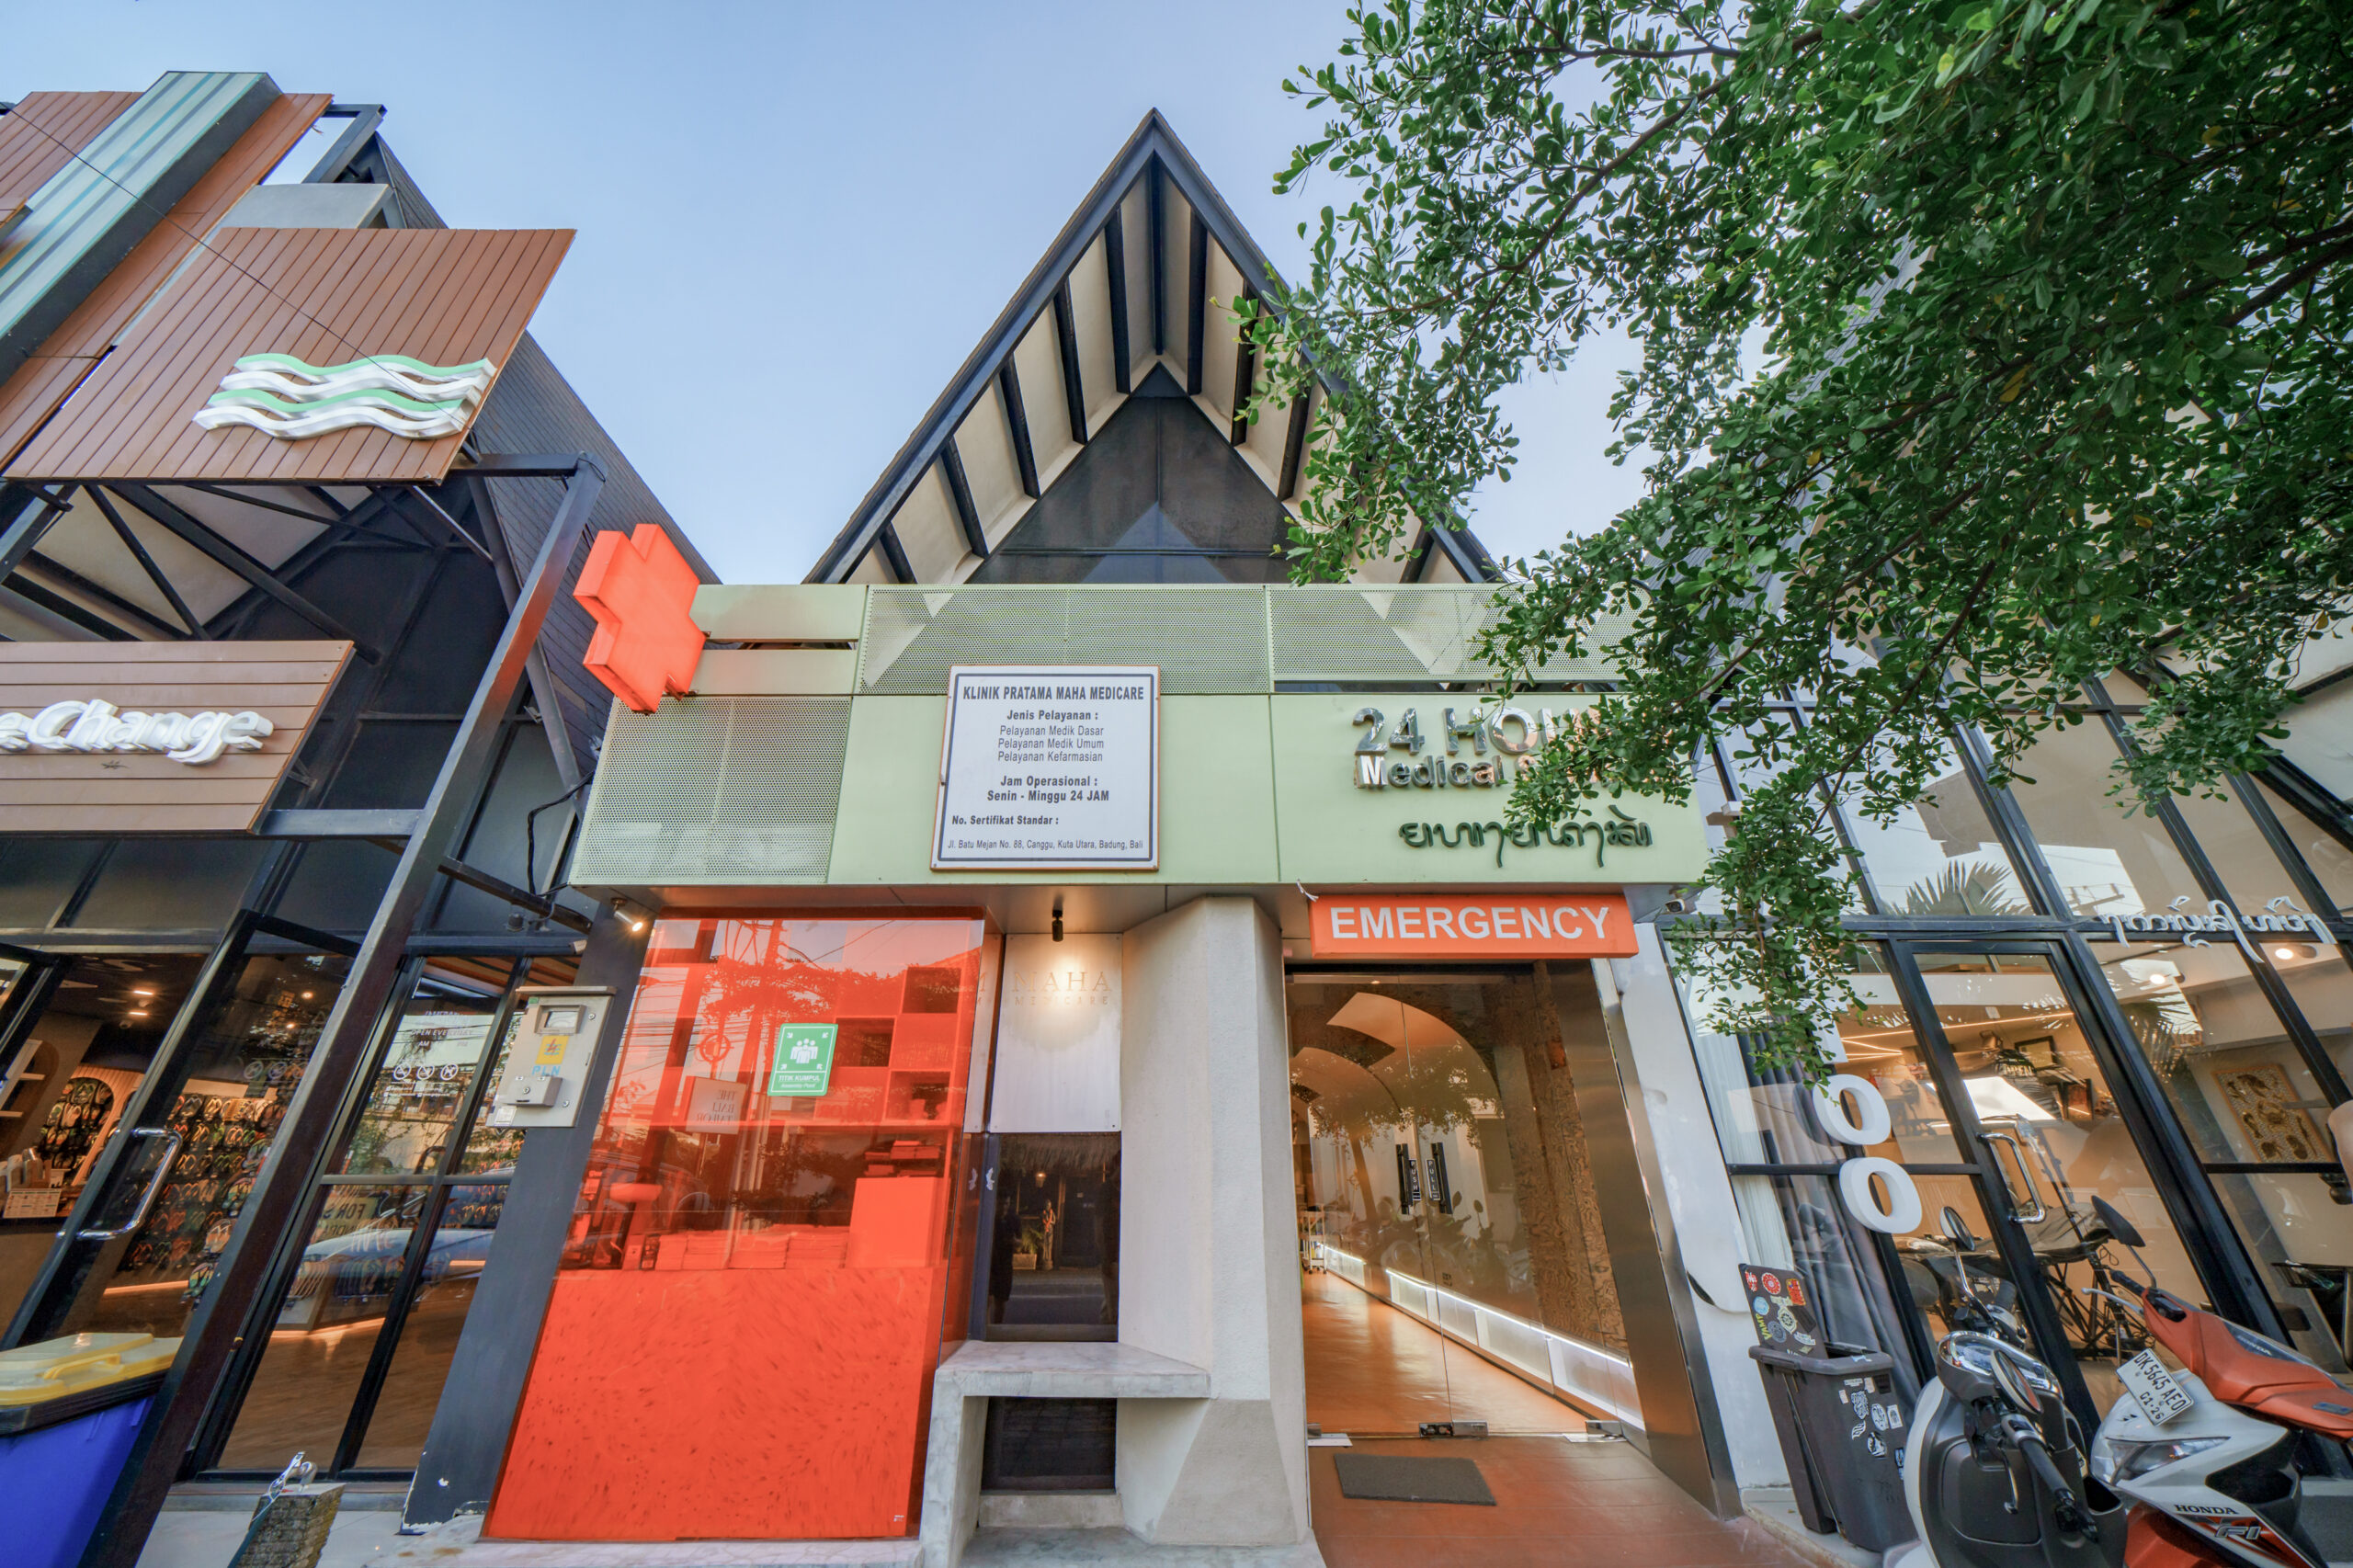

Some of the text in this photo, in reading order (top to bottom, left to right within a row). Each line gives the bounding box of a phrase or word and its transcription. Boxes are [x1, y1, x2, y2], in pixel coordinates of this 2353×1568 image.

[963, 686, 1144, 699] KLINIK PRATAMA MAHA MEDICARE
[1006, 710, 1035, 720] Jenis
[1039, 710, 1091, 722] Pelayanan
[27, 699, 274, 765] Change
[1000, 726, 1104, 736] Pelayanan Medik Dasar
[1352, 708, 1426, 756] 24
[998, 739, 1104, 750] Pelayanan Medik Umum
[998, 751, 1103, 764] Pelayanan Kefarmasian
[1354, 755, 1505, 789] Medical
[1000, 776, 1023, 786] Jam
[1026, 776, 1090, 788] Operasional
[987, 790, 1017, 801] Senin
[1028, 790, 1066, 803] Minggu
[1070, 790, 1084, 801] 24
[1086, 790, 1109, 801] JAM
[952, 815, 967, 824] No.
[970, 815, 1014, 824] Sertifikat
[1017, 815, 1053, 824] Standar
[948, 839, 1142, 850] Jl. Batu Mejan No. 88, Canggu, Kuta Utara, Badung, Bali
[1330, 906, 1610, 939] EMERGENCY
[1012, 971, 1111, 993] MAHA
[1015, 996, 1108, 1006] MEDICARE
[531, 1065, 561, 1075] PLN
[2133, 1352, 2154, 1370] DK
[2143, 1366, 2171, 1390] 5645
[2174, 1505, 2239, 1514] HONDA
